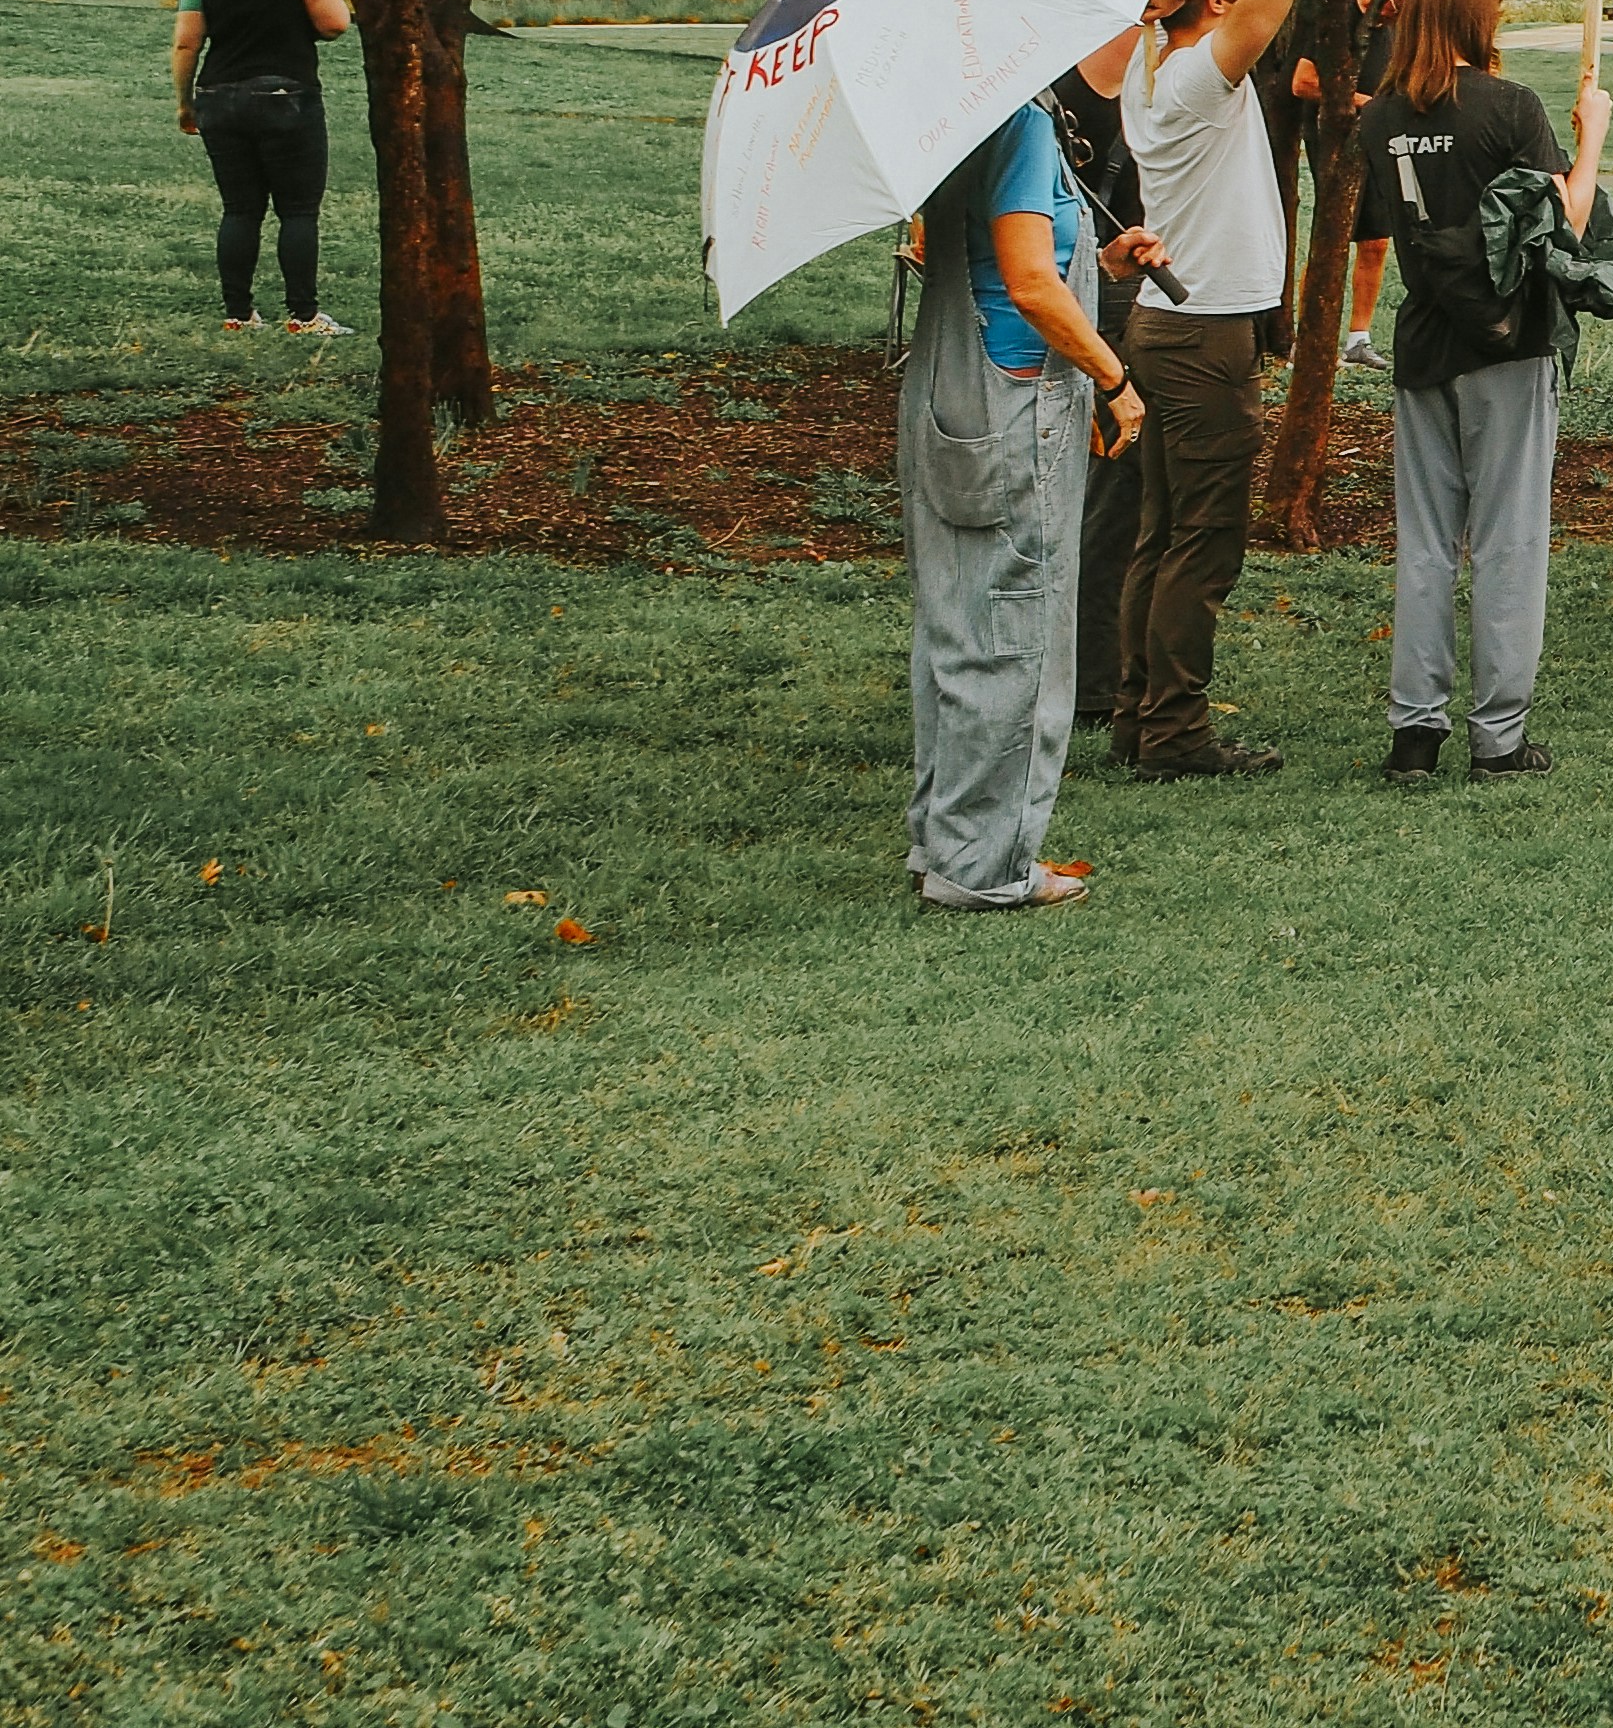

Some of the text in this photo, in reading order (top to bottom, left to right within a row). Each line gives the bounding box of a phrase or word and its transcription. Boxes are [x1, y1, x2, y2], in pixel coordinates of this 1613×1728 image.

[745, 8, 840, 92] KEEP
[918, 116, 958, 154] OUR
[1388, 133, 1454, 155] STAFF
